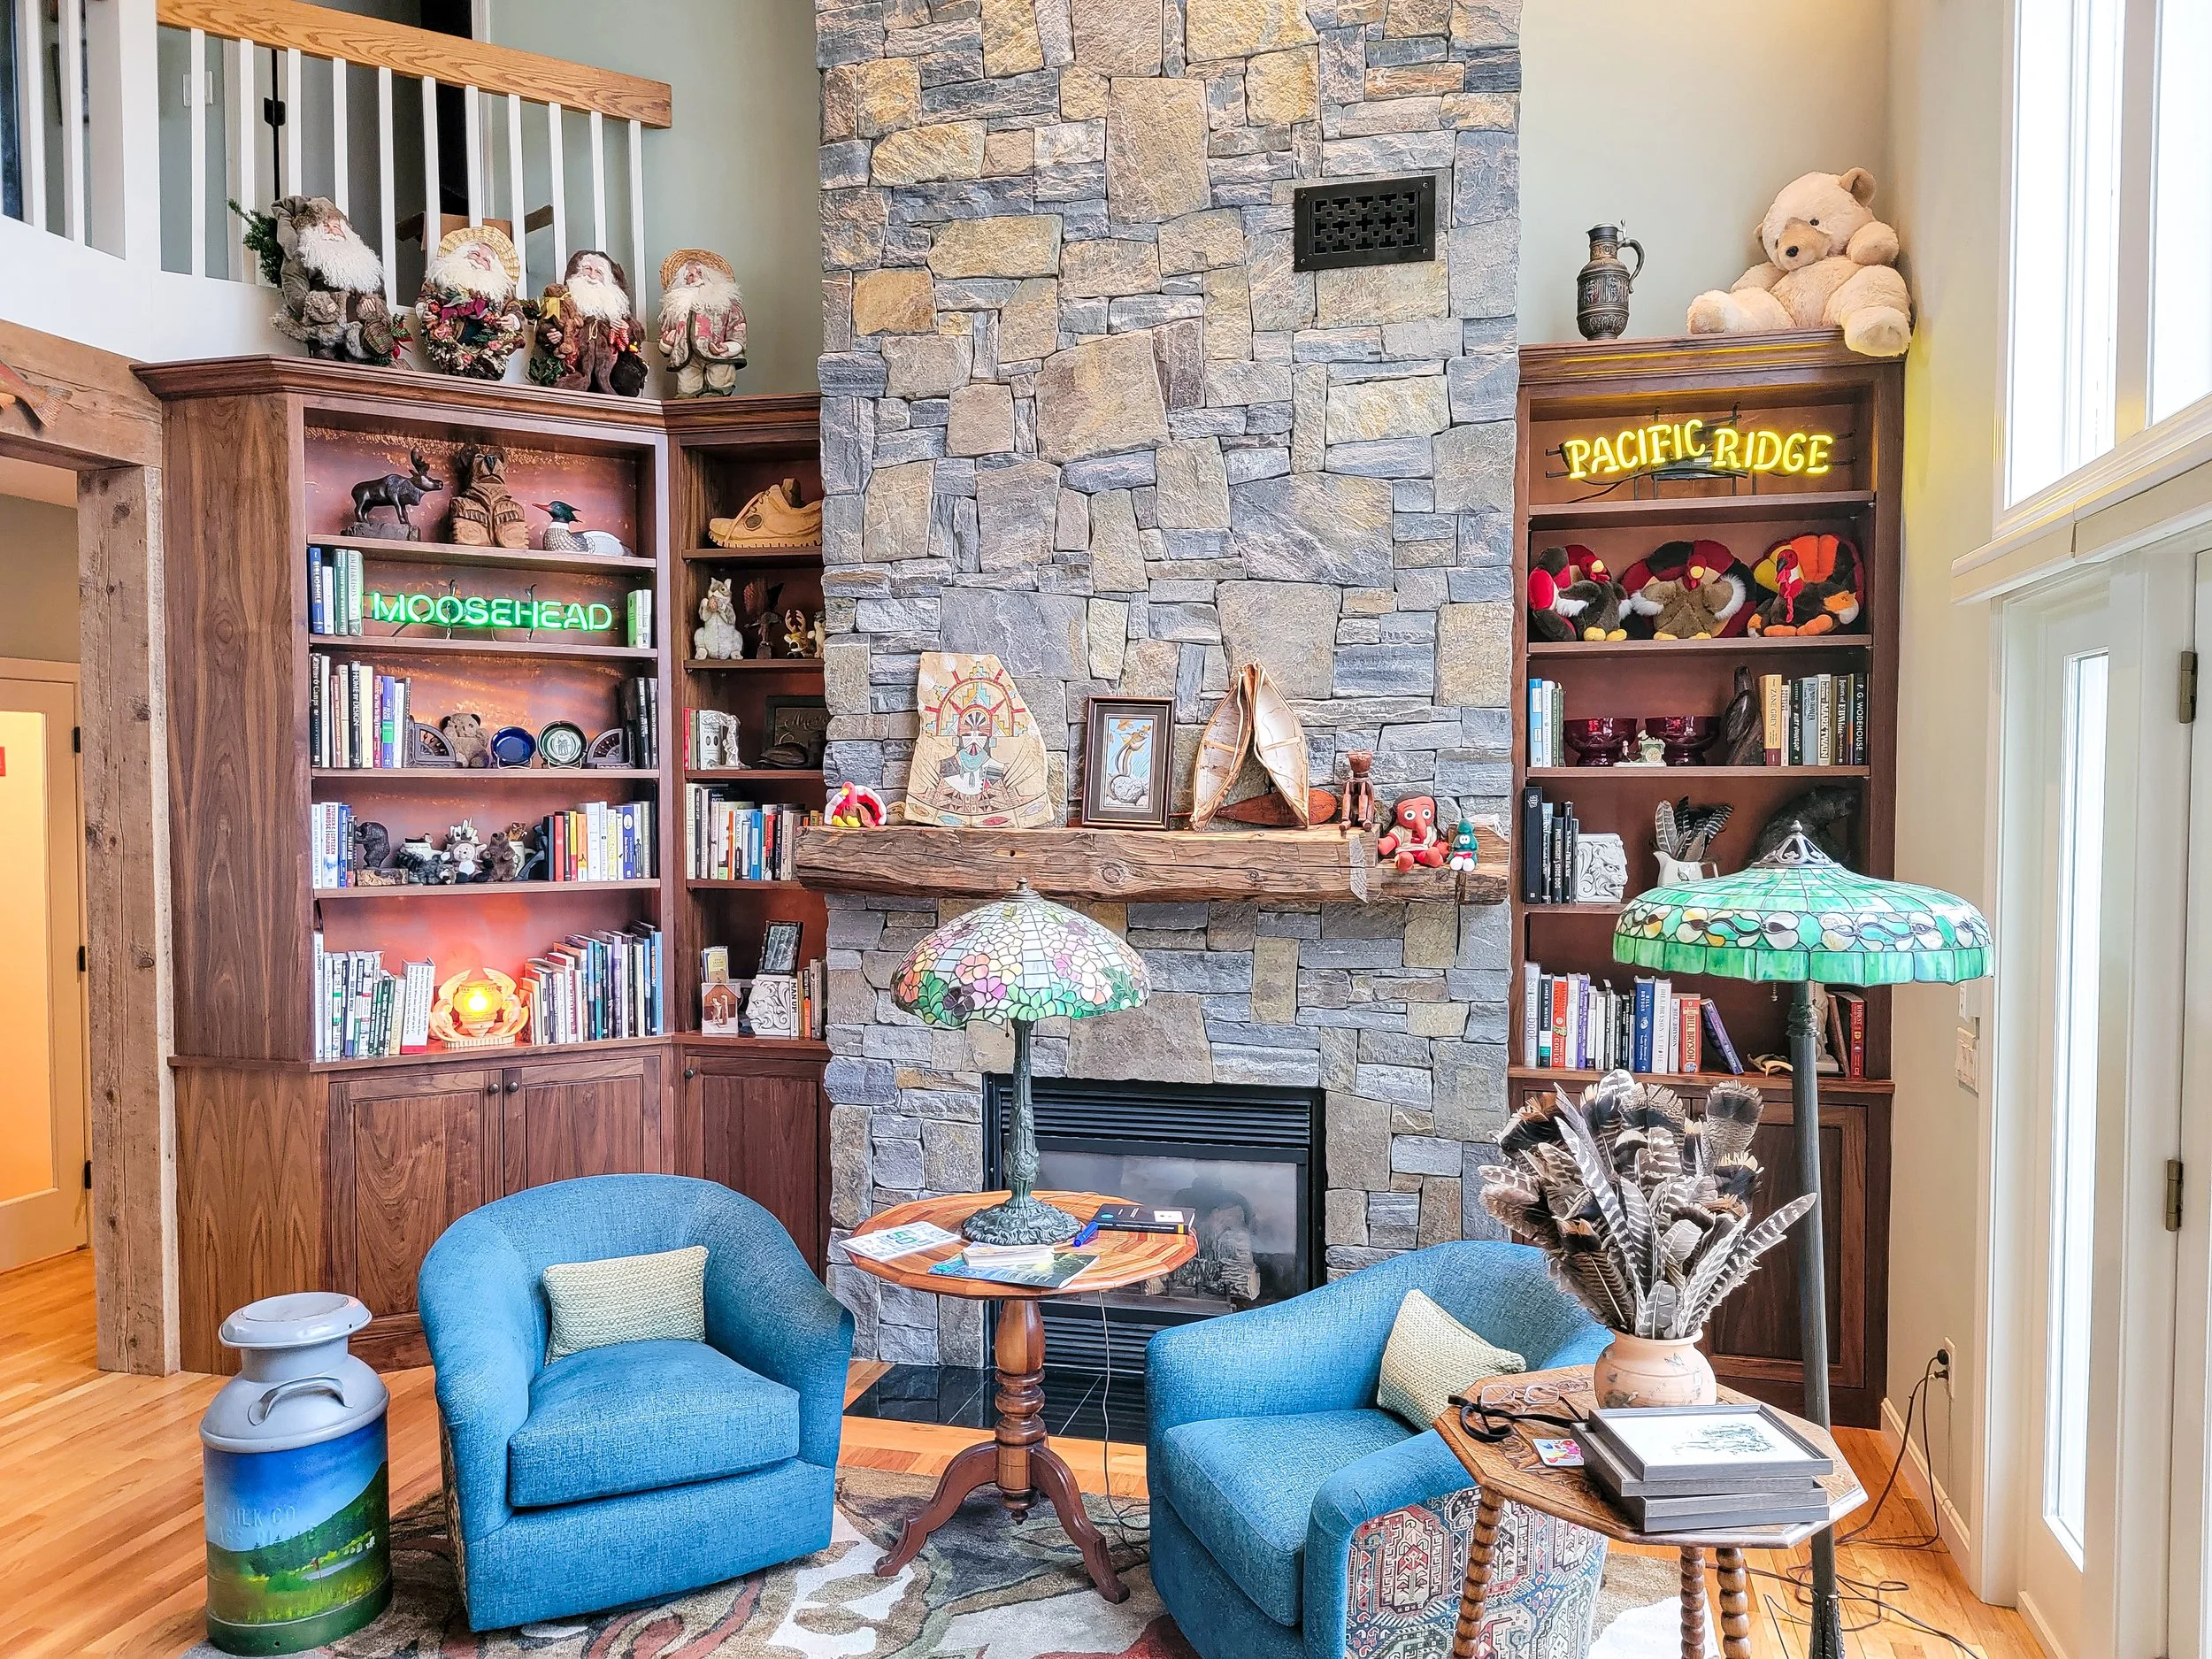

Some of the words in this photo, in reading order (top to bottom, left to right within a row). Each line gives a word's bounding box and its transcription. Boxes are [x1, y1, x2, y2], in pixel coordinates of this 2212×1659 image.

[1565, 419, 1707, 479] PACIFIC
[1713, 427, 1835, 474] RIDGE
[349, 565, 358, 597] HARRISON
[372, 592, 614, 632] MOOSEHEAD
[311, 685, 321, 706] Camps
[1856, 691, 1864, 701] G.
[1820, 702, 1829, 729] MARK
[1855, 701, 1864, 751] WODEHOUSE
[1820, 730, 1829, 758] TWAIN
[1542, 808, 1551, 833] Stanford
[1686, 1015, 1695, 1030] BILL
[1657, 1033, 1664, 1043] AT
[1686, 1030, 1695, 1060] BRYSON
[1727, 1051, 1737, 1067] BRYSON
